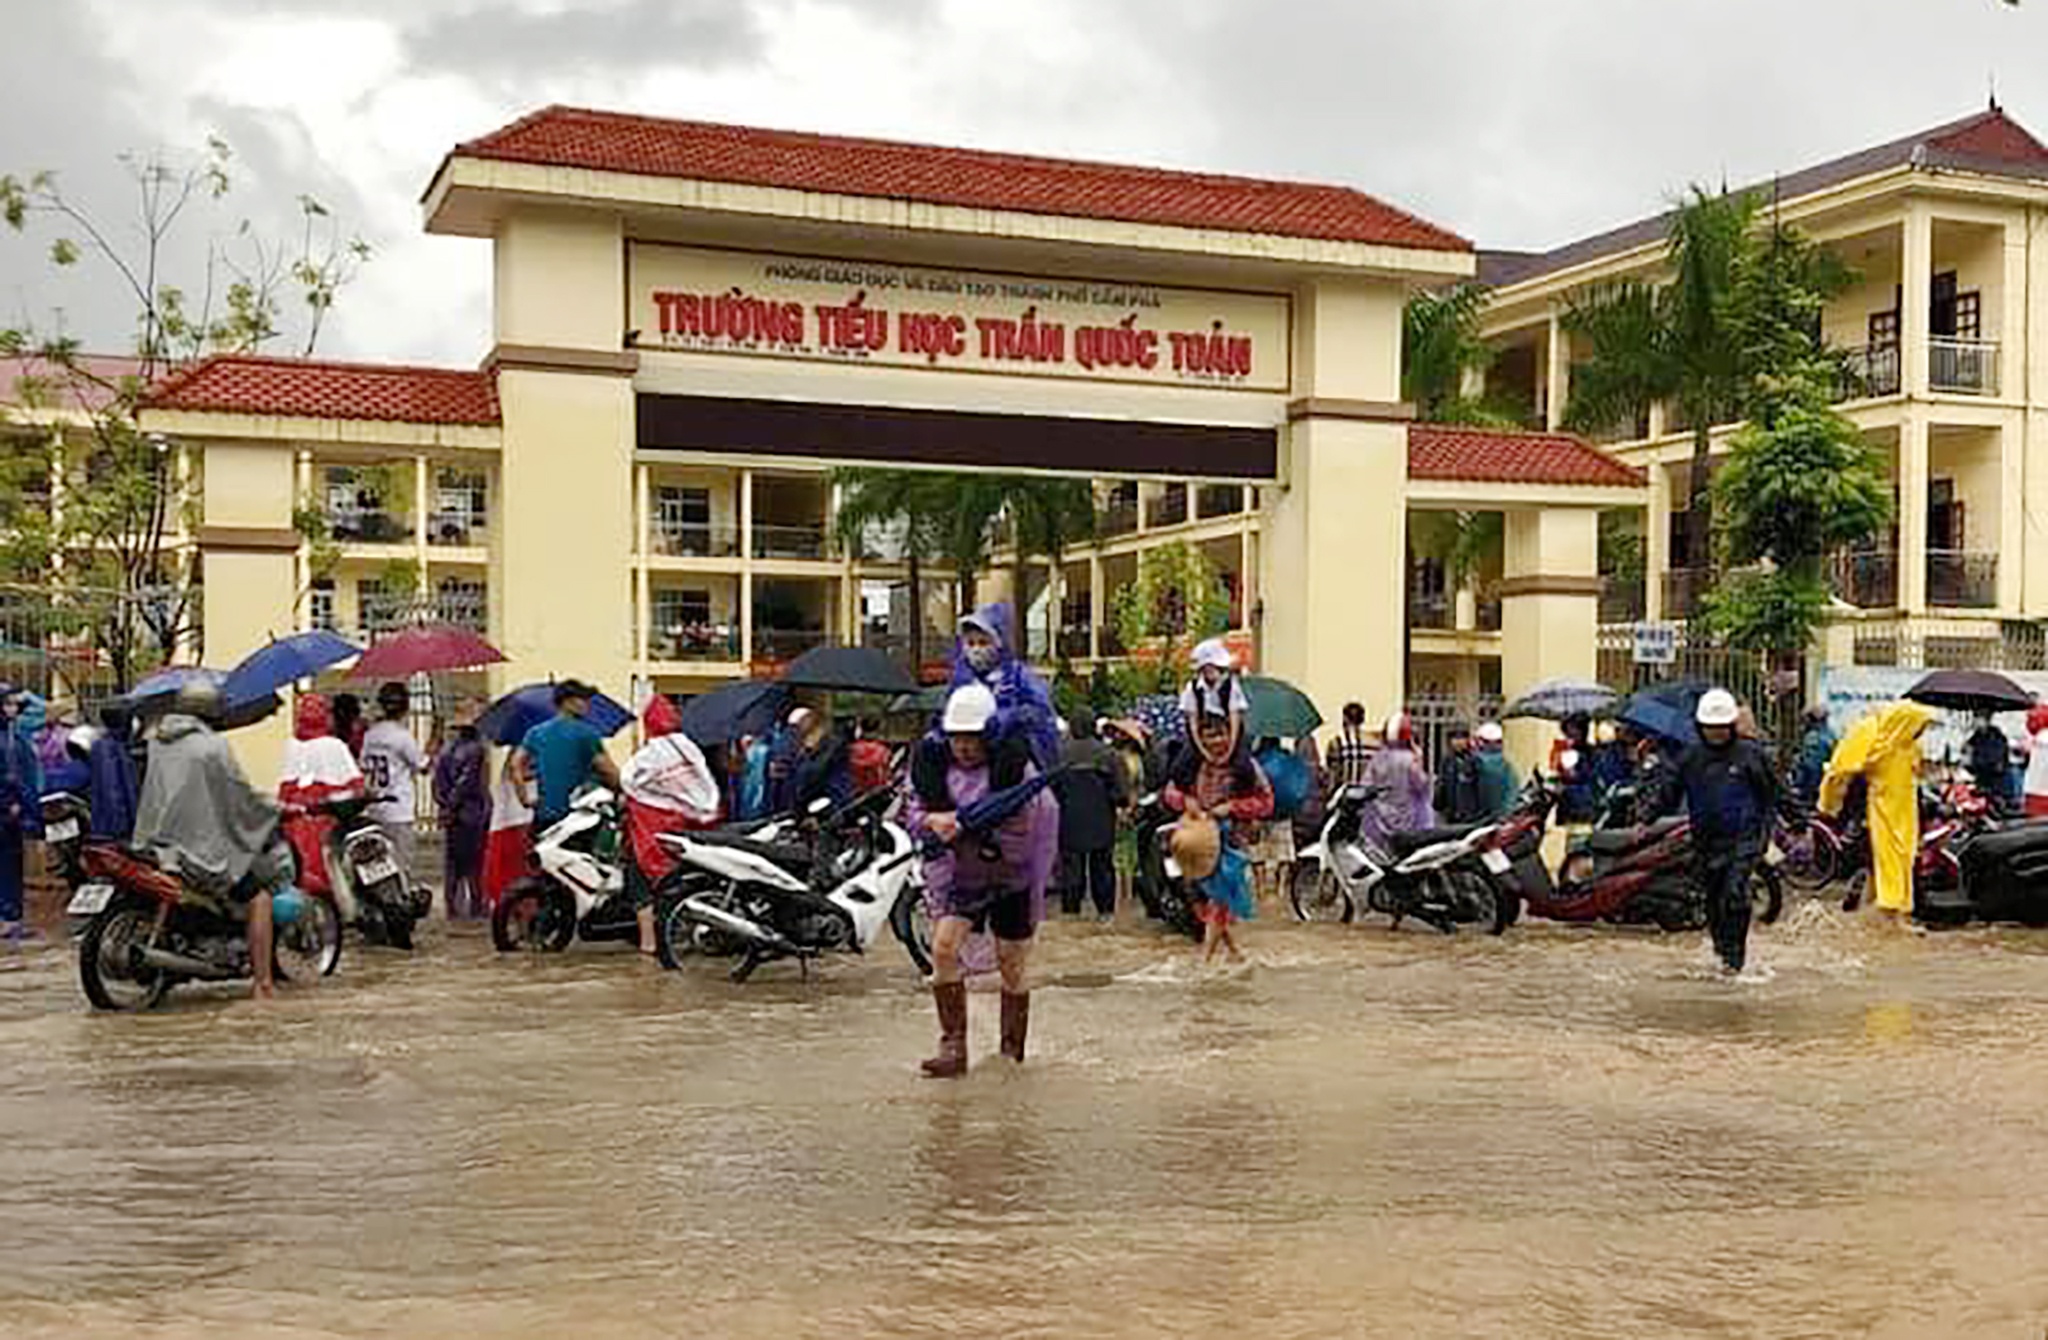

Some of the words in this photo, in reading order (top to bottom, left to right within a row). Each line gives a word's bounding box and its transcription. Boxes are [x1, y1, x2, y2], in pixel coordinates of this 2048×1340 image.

[653, 287, 803, 343] TRƯỜNG
[899, 312, 966, 362] HỌC
[1075, 313, 1158, 370] QUỐC
[1168, 320, 1251, 376] TOẢN
